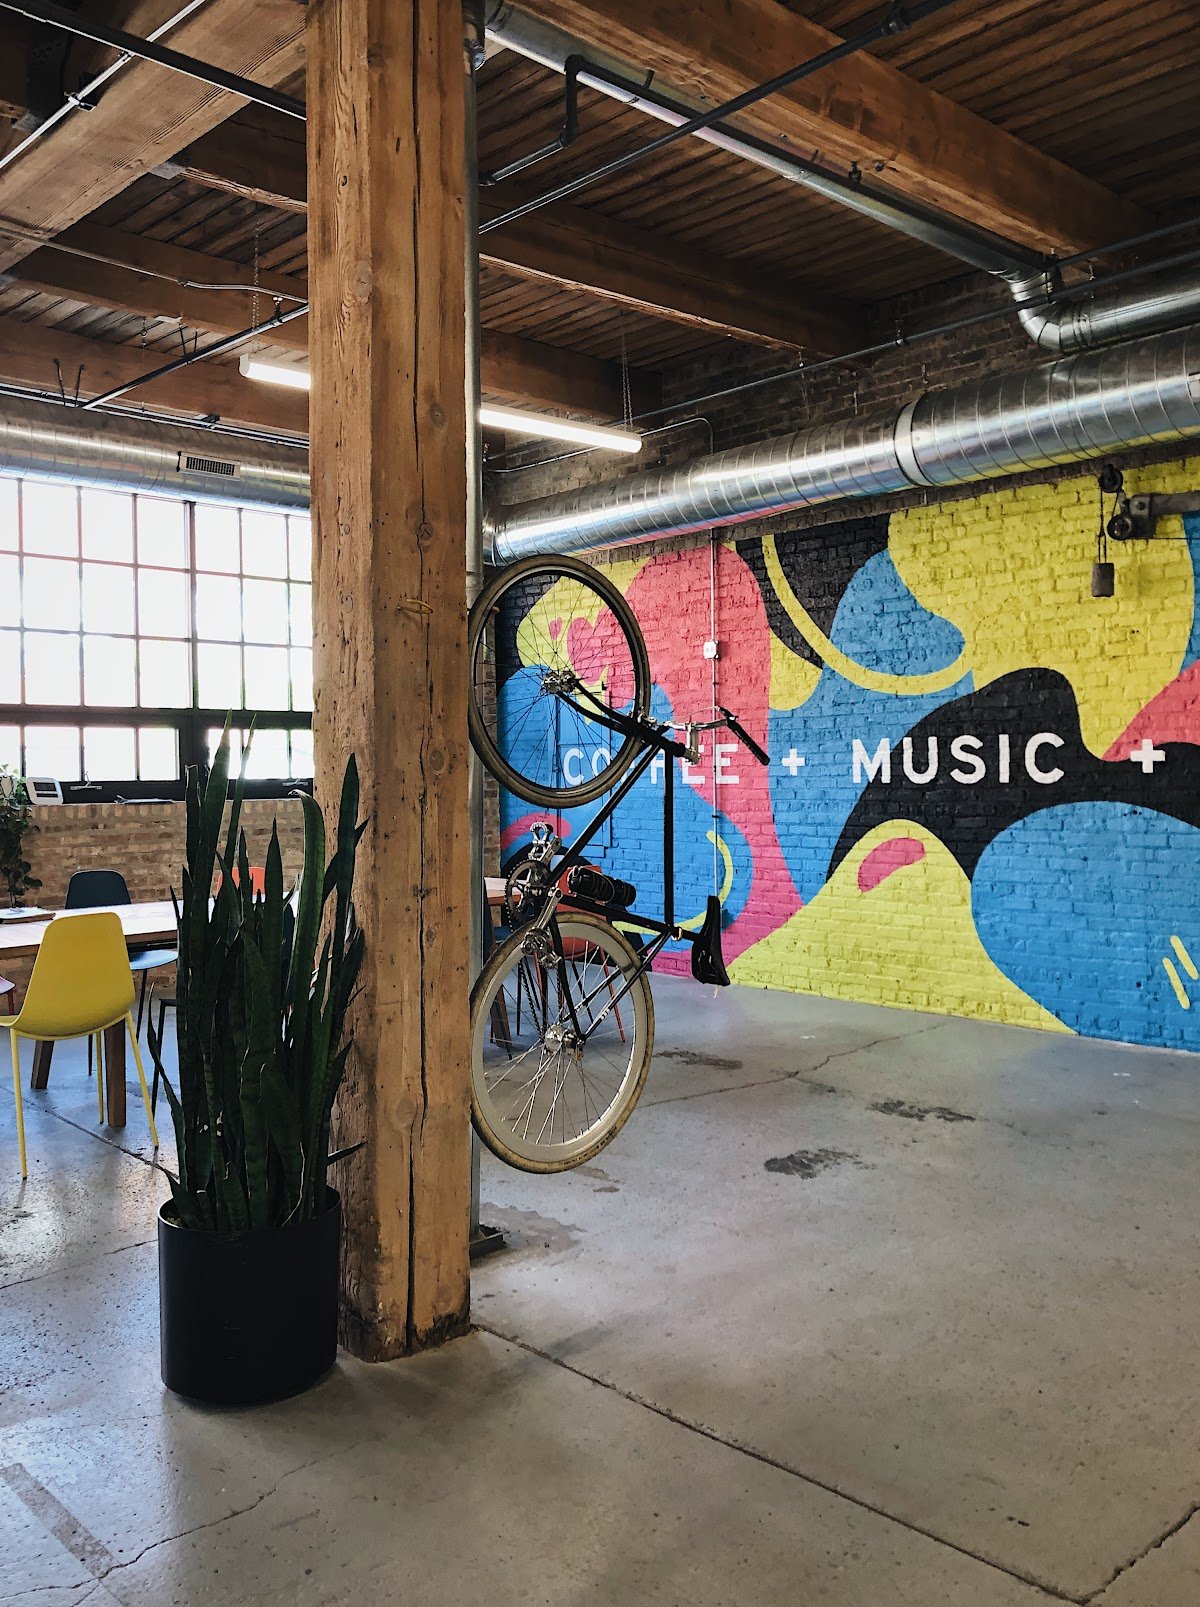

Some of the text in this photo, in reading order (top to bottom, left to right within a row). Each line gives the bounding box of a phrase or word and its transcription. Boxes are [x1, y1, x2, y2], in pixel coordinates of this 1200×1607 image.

[563, 732, 1166, 785] COEE + MUSIC +
